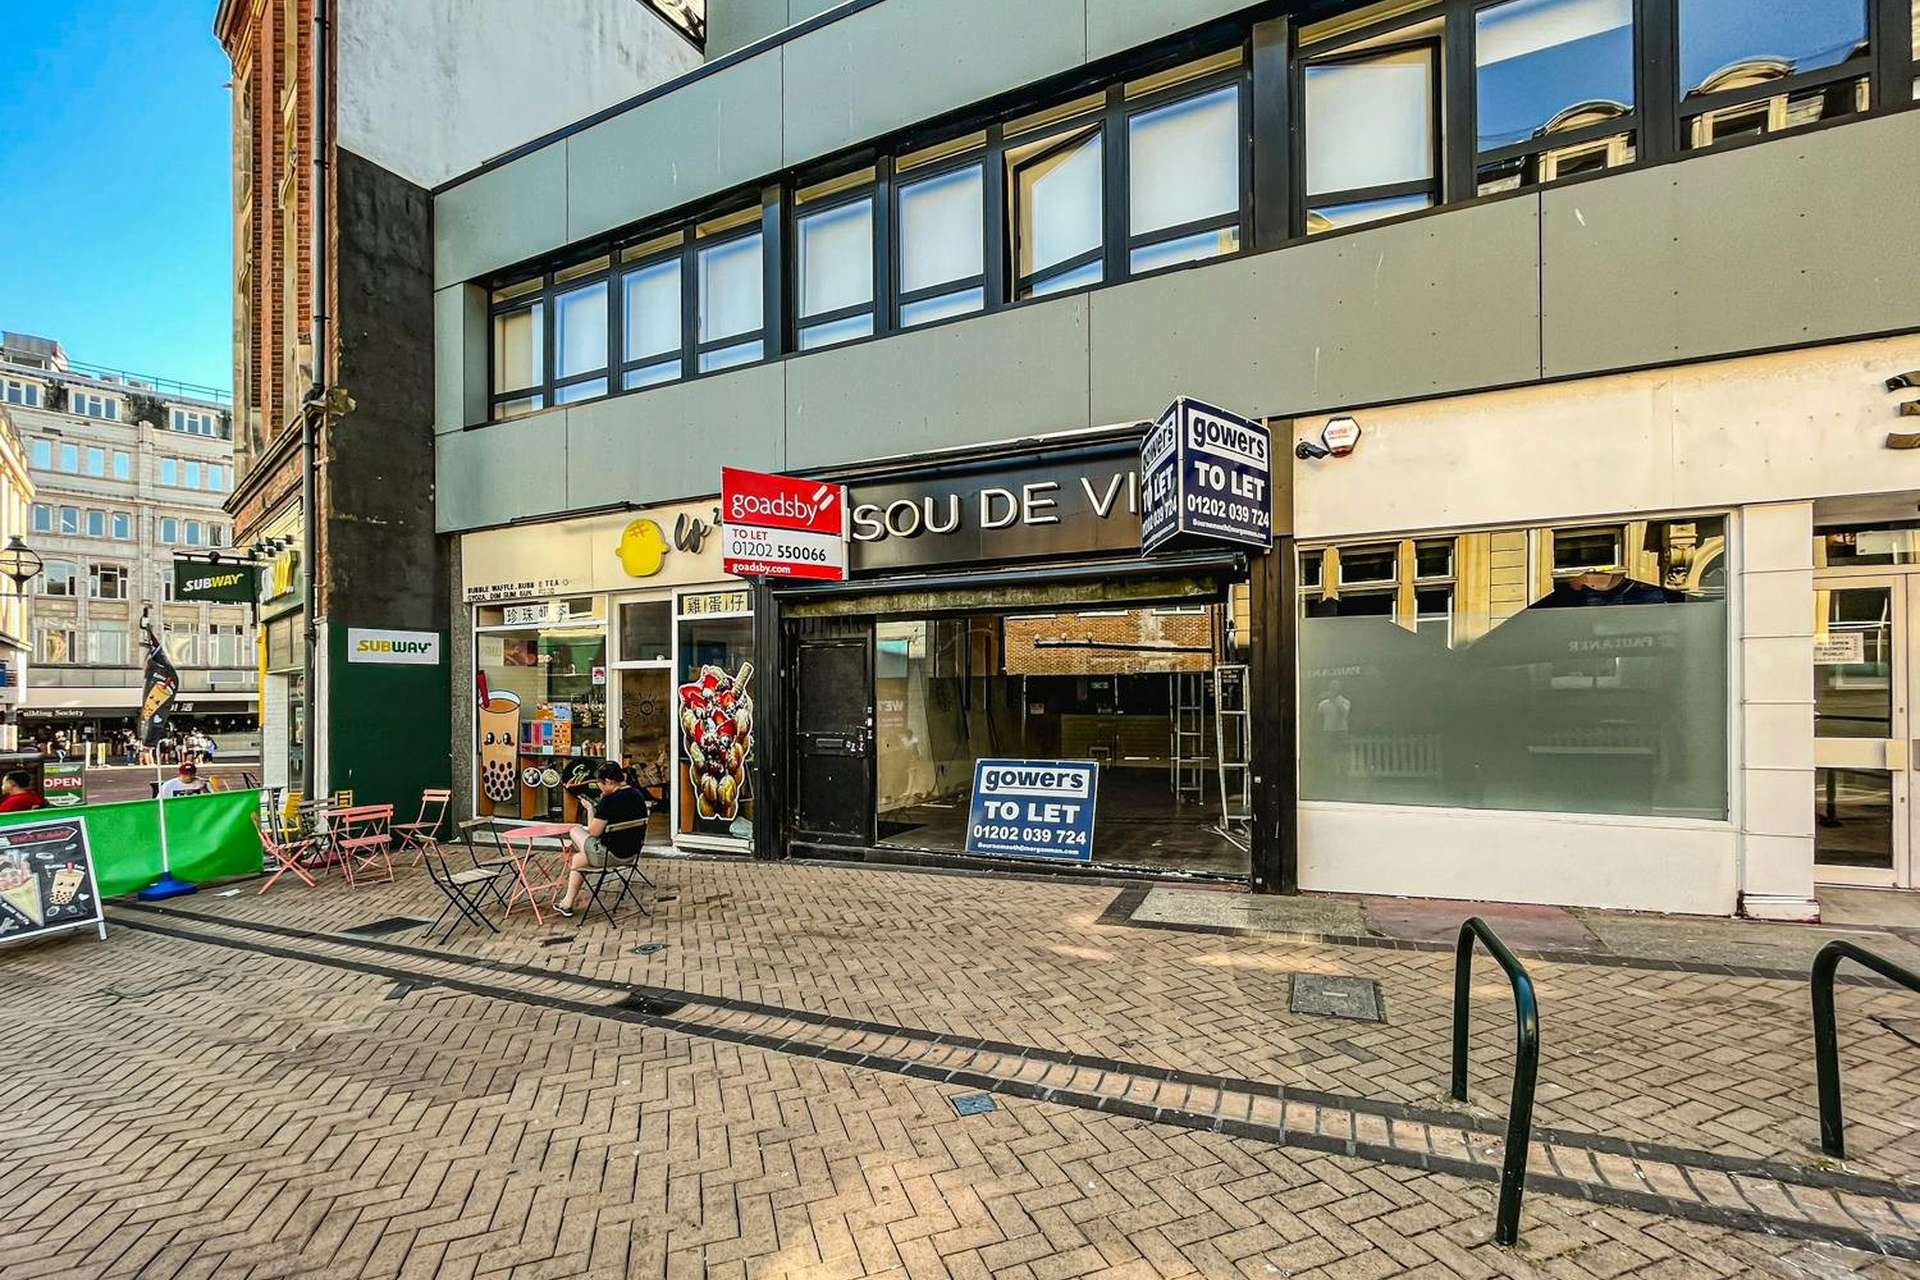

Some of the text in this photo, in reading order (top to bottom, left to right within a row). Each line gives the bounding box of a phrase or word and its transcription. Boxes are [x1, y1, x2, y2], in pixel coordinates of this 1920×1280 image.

[1193, 417, 1265, 459] gowers
[1154, 464, 1174, 501] LET
[1194, 460, 1265, 501] TO LET
[731, 491, 818, 526] goadsby
[979, 480, 1060, 529] DE
[1187, 494, 1270, 528] 01202 039 724
[732, 528, 768, 541] TO LET
[732, 541, 827, 562] 01202 550066
[732, 562, 791, 575] goadsby.com
[183, 572, 244, 592] SUBWAY
[357, 639, 433, 654] SUBWAY
[54, 709, 85, 717] Society
[43, 777, 82, 788] OPEN
[985, 769, 1084, 791] gowers
[983, 800, 1081, 824] TO LET
[973, 825, 1087, 845] 01202 039 724
